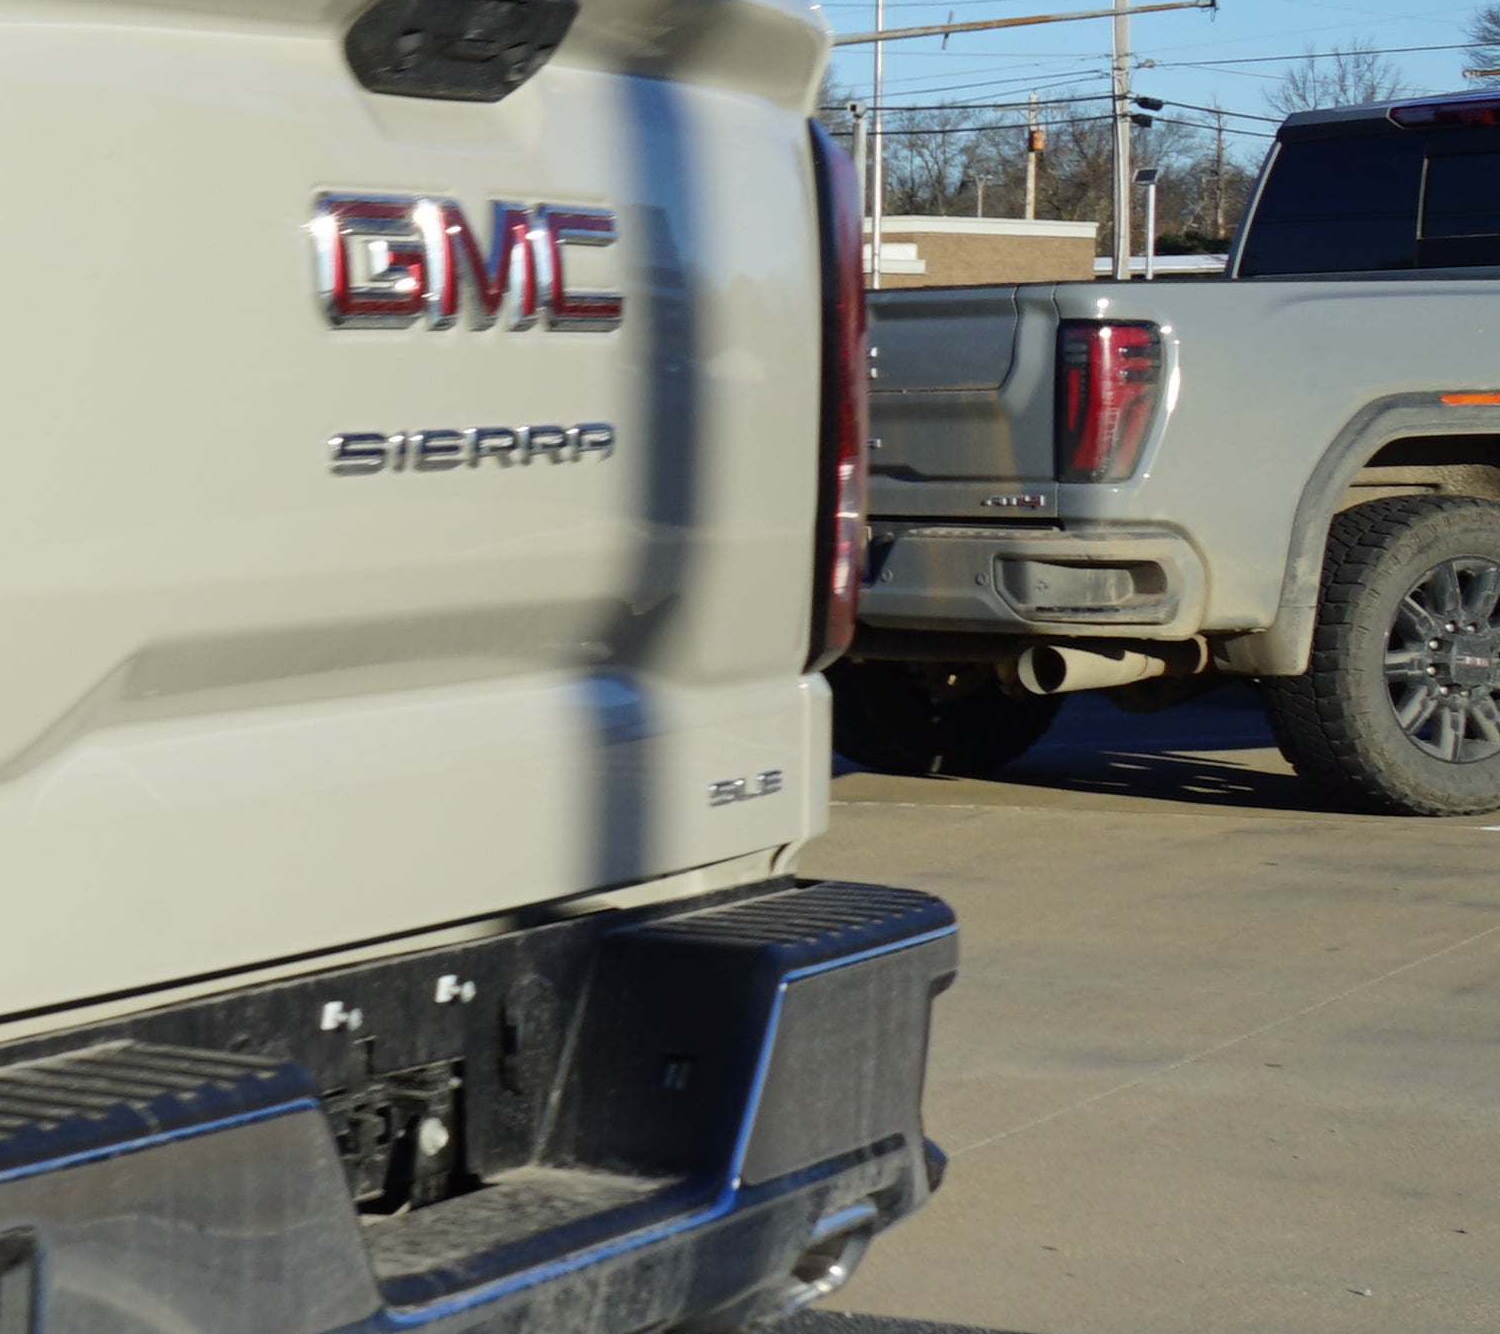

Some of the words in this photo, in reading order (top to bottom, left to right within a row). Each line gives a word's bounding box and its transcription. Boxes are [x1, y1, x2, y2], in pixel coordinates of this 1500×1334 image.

[310, 190, 623, 332] GMC
[327, 422, 615, 476] SIERRA
[707, 769, 782, 807] SLE
